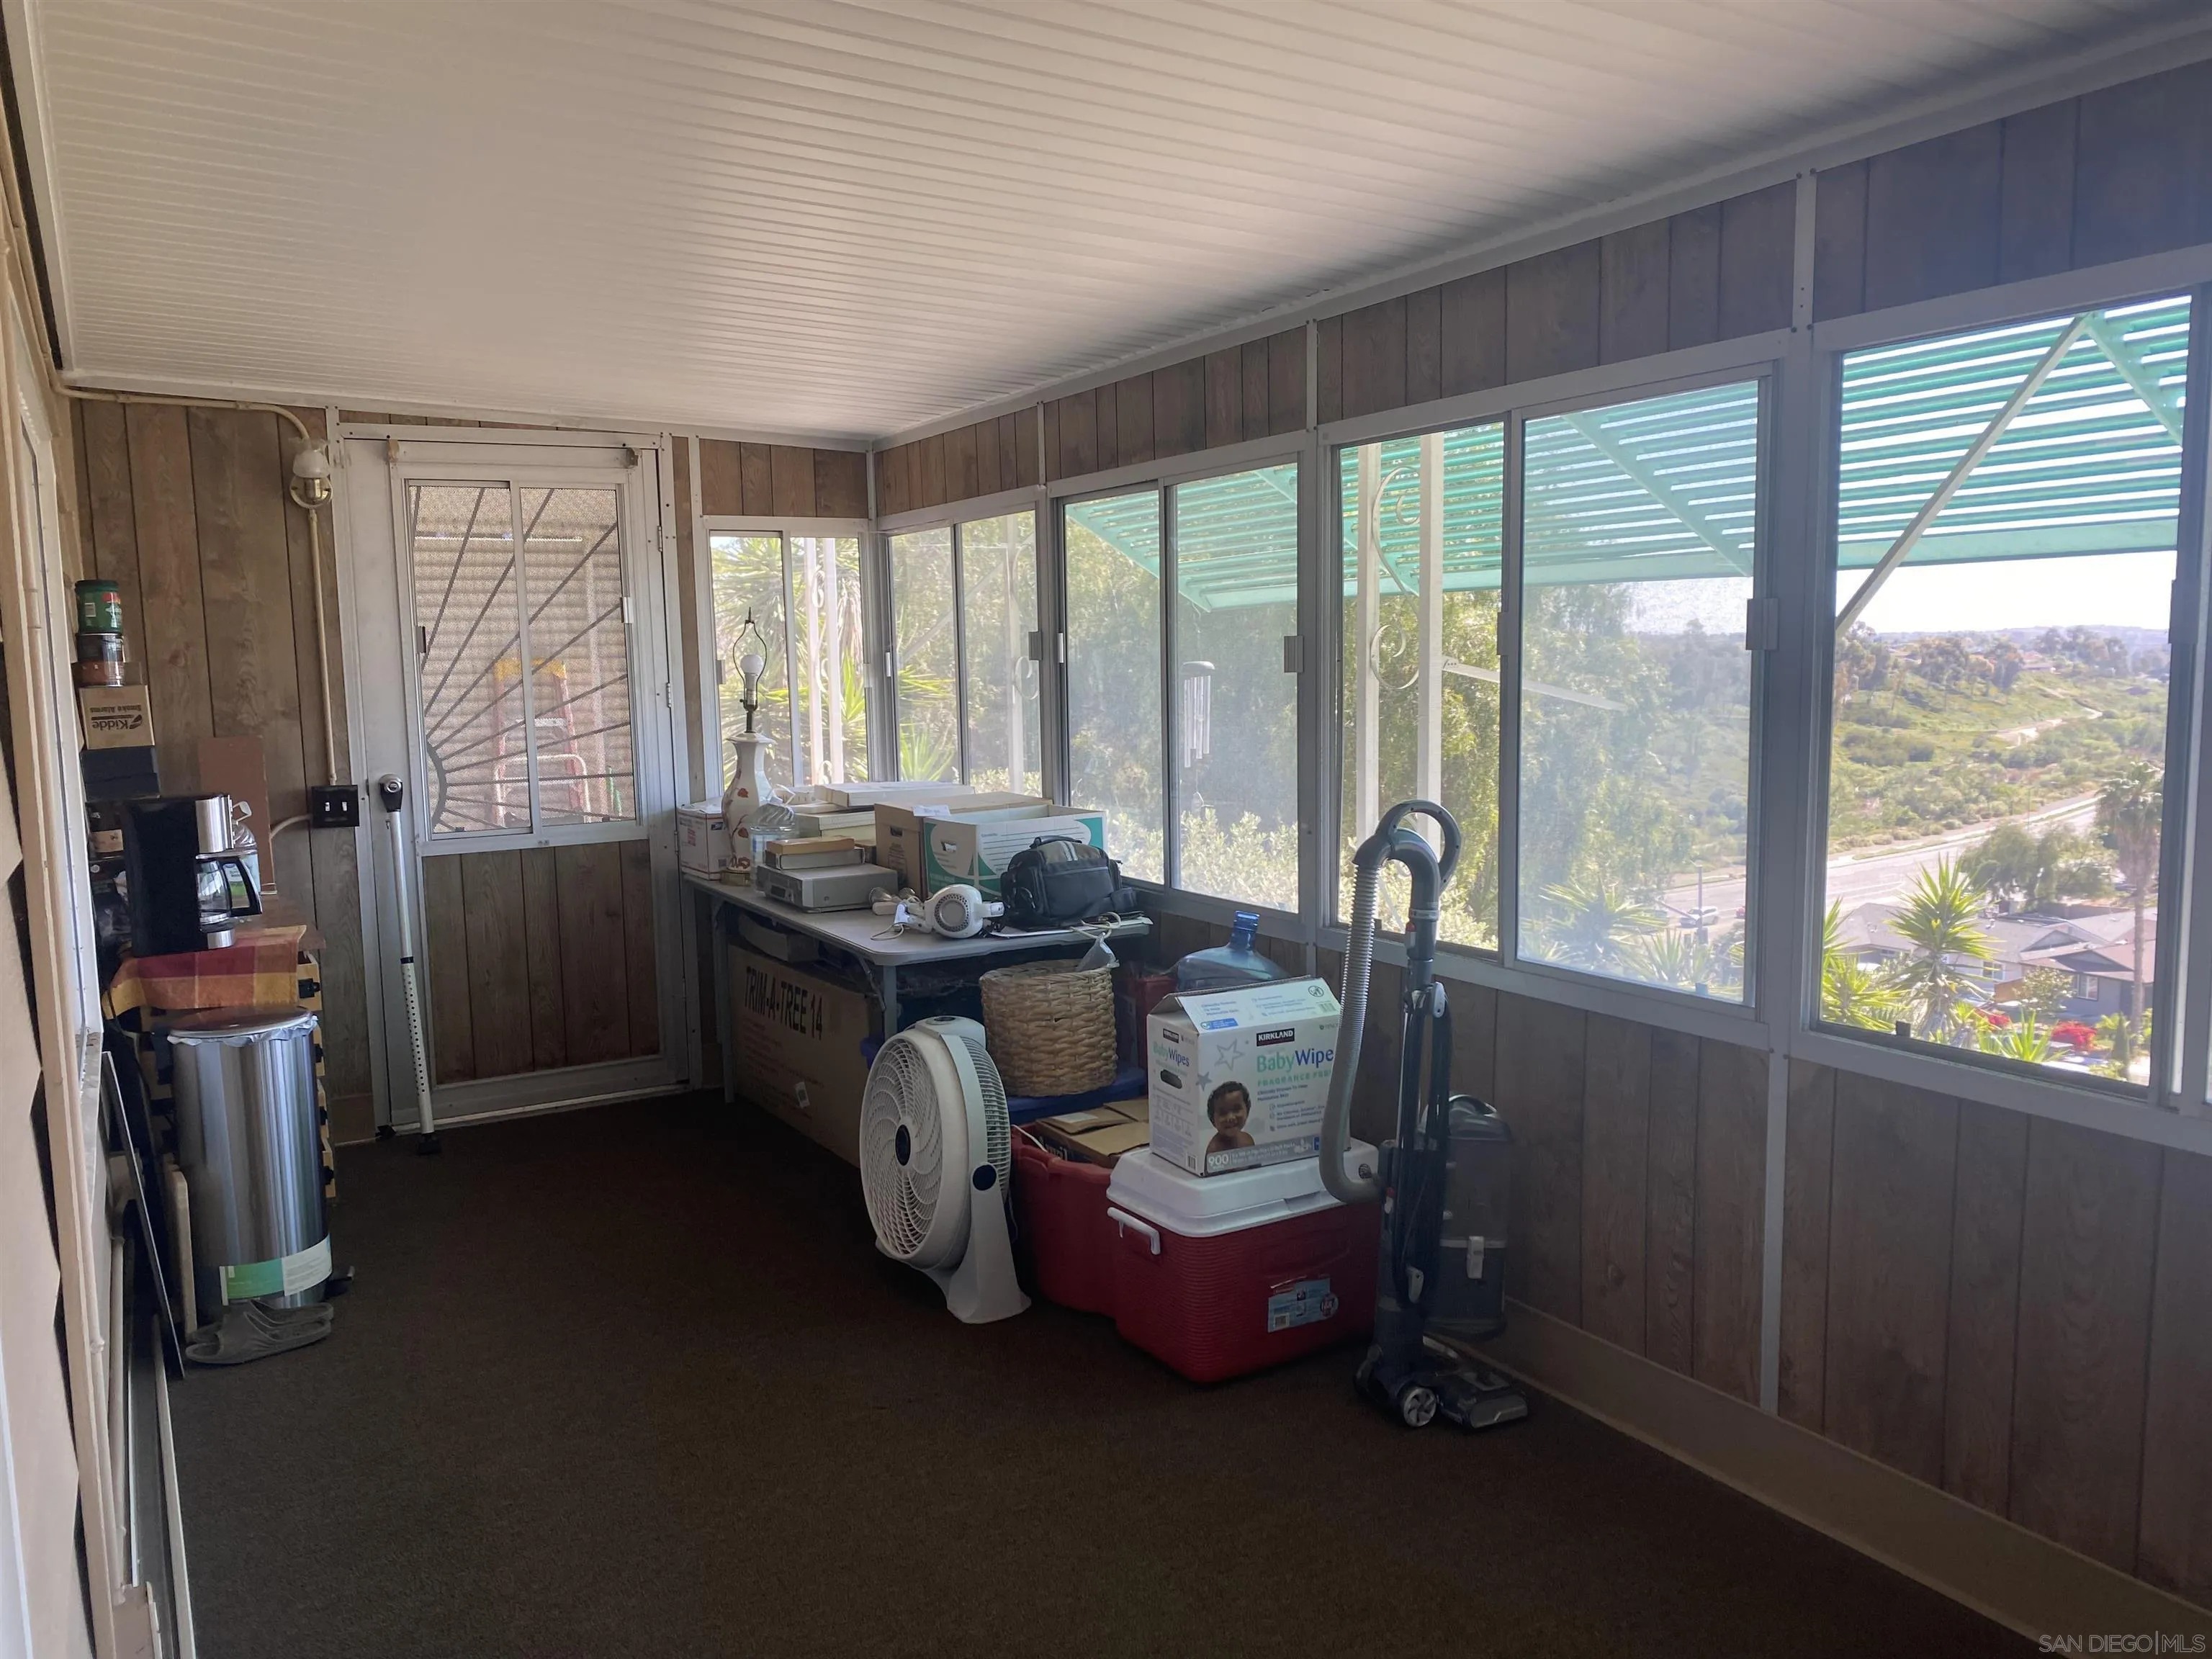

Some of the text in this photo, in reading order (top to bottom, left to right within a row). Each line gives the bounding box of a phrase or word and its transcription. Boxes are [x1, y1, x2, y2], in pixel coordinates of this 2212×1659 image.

[92, 720, 129, 731] Kidde
[745, 966, 822, 1041] TRIM-A-TREE 14
[1258, 1030, 1294, 1042] KIRKLAND
[1256, 1048, 1335, 1073] BabyWipe
[1208, 1154, 1229, 1166] 900
